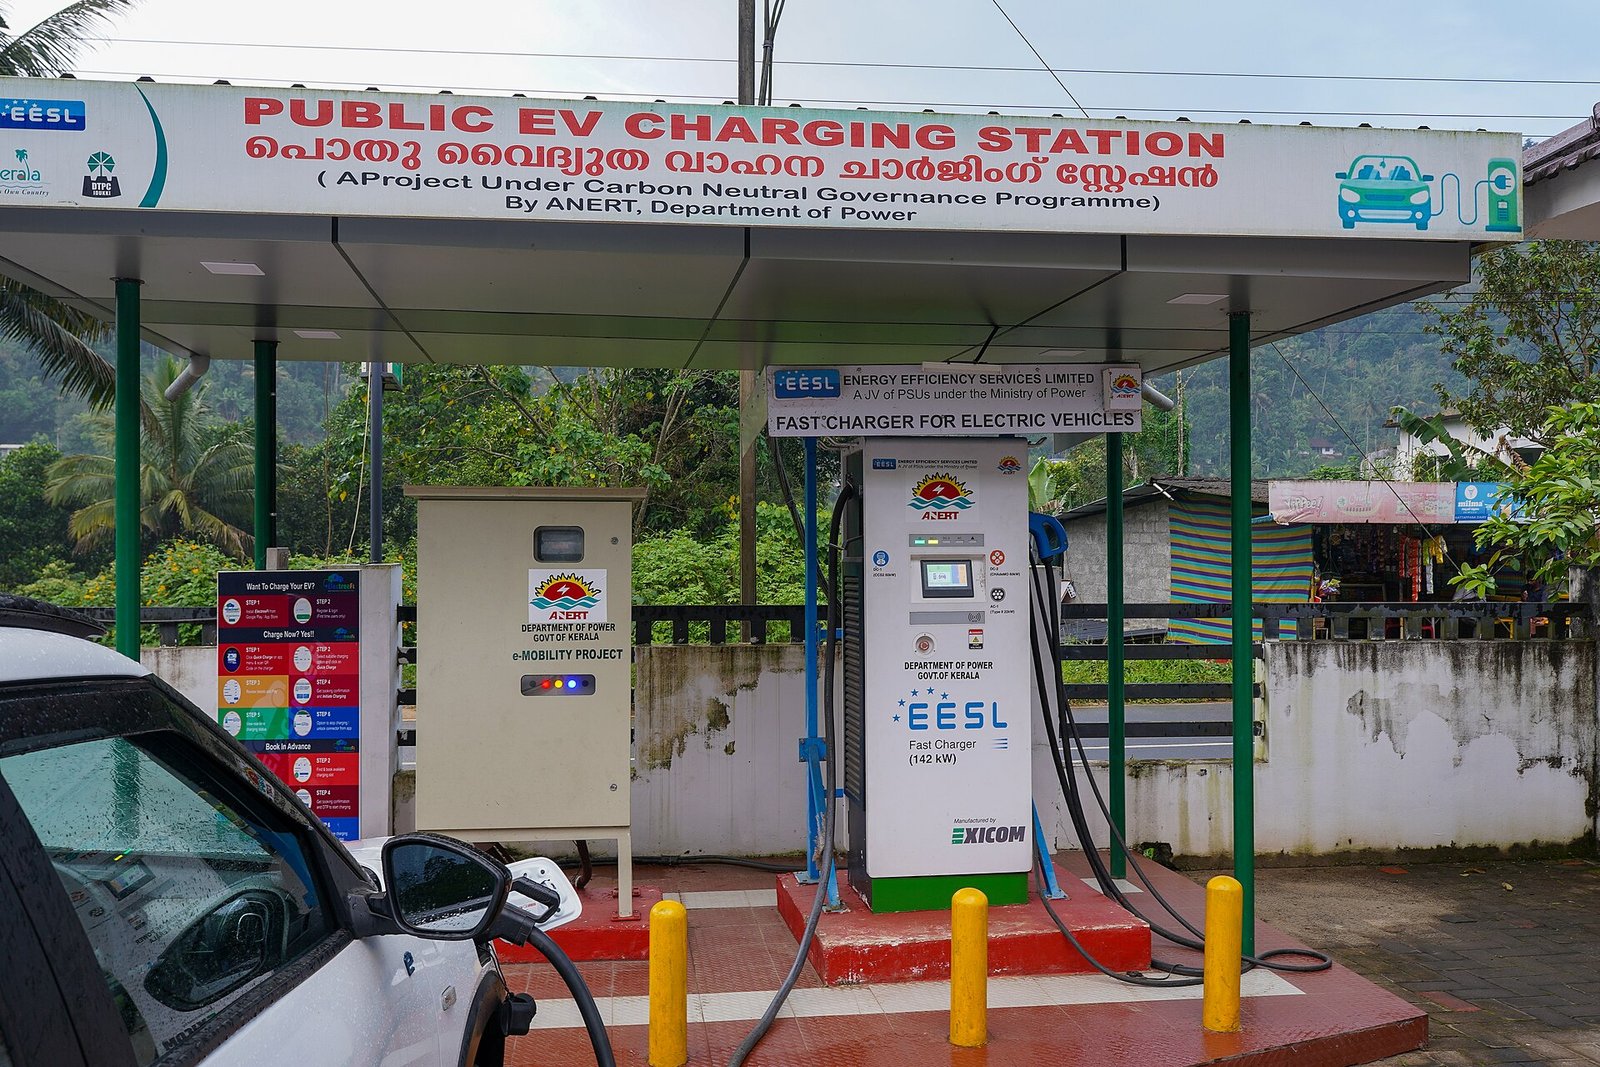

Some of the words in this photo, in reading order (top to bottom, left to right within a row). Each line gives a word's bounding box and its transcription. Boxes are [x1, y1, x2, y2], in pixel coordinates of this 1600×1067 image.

[11, 107, 77, 123] EESL
[245, 98, 493, 132] PUBLIC
[519, 108, 602, 136] EV
[625, 113, 956, 150] CHARGING
[978, 126, 1224, 158] STATION
[246, 136, 420, 170] പൊതു
[665, 151, 824, 176] വാഹന
[0, 159, 41, 181] erala
[92, 182, 112, 191] DTPC
[337, 172, 472, 190] AProject
[482, 176, 575, 191] Under
[584, 180, 691, 195] Carbon
[703, 183, 806, 199] Neutral
[817, 188, 986, 204] Governance
[997, 193, 1159, 211] Programme)
[506, 196, 538, 212] By
[546, 197, 641, 215] ANERT,
[652, 201, 801, 217] Department
[808, 206, 832, 218] of
[842, 207, 917, 221] Power
[786, 377, 834, 391] EESL
[844, 375, 897, 385] ENERGY
[901, 374, 976, 384] EFFICIENCY
[980, 374, 1041, 384] SERVICES
[1046, 374, 1094, 386] LIMITED
[853, 390, 862, 399] A
[865, 390, 879, 399] JV
[884, 389, 894, 399] of
[898, 389, 930, 399] PSUs
[934, 389, 966, 399] under
[970, 389, 986, 398] the
[991, 389, 1033, 400] Ministry
[1037, 388, 1047, 398] of
[1051, 388, 1086, 398] Power
[776, 416, 820, 430] FAST
[826, 415, 914, 430] CHARGER
[920, 415, 955, 428] FOR
[962, 414, 1045, 427] ELECTRIC
[1051, 413, 1134, 426] VEHICLES
[269, 583, 289, 592] Charge
[303, 582, 316, 590] EV?
[522, 624, 574, 632] DEPARTMENT
[576, 624, 586, 632] OF
[588, 624, 616, 632] POWER
[263, 631, 283, 640] Charge
[284, 630, 300, 638] Now?
[300, 630, 315, 638] Yes!!
[533, 634, 555, 642] GOVT
[556, 634, 566, 642] OF
[568, 633, 599, 641] KERALA
[512, 650, 572, 661] e-MOBILITY
[576, 649, 623, 660] PROJECT
[904, 661, 954, 669] DEPARTMENT
[955, 661, 965, 669] OF
[967, 661, 993, 669] POWER
[917, 672, 949, 680] GOVT.OF
[950, 672, 980, 680] KERALA
[908, 701, 1008, 730] EESL
[909, 740, 932, 750] Fast
[934, 739, 977, 751] Charger
[909, 754, 932, 766] (142
[936, 753, 957, 766] kW)
[989, 817, 996, 825] by
[952, 826, 1026, 845] EXICOM
